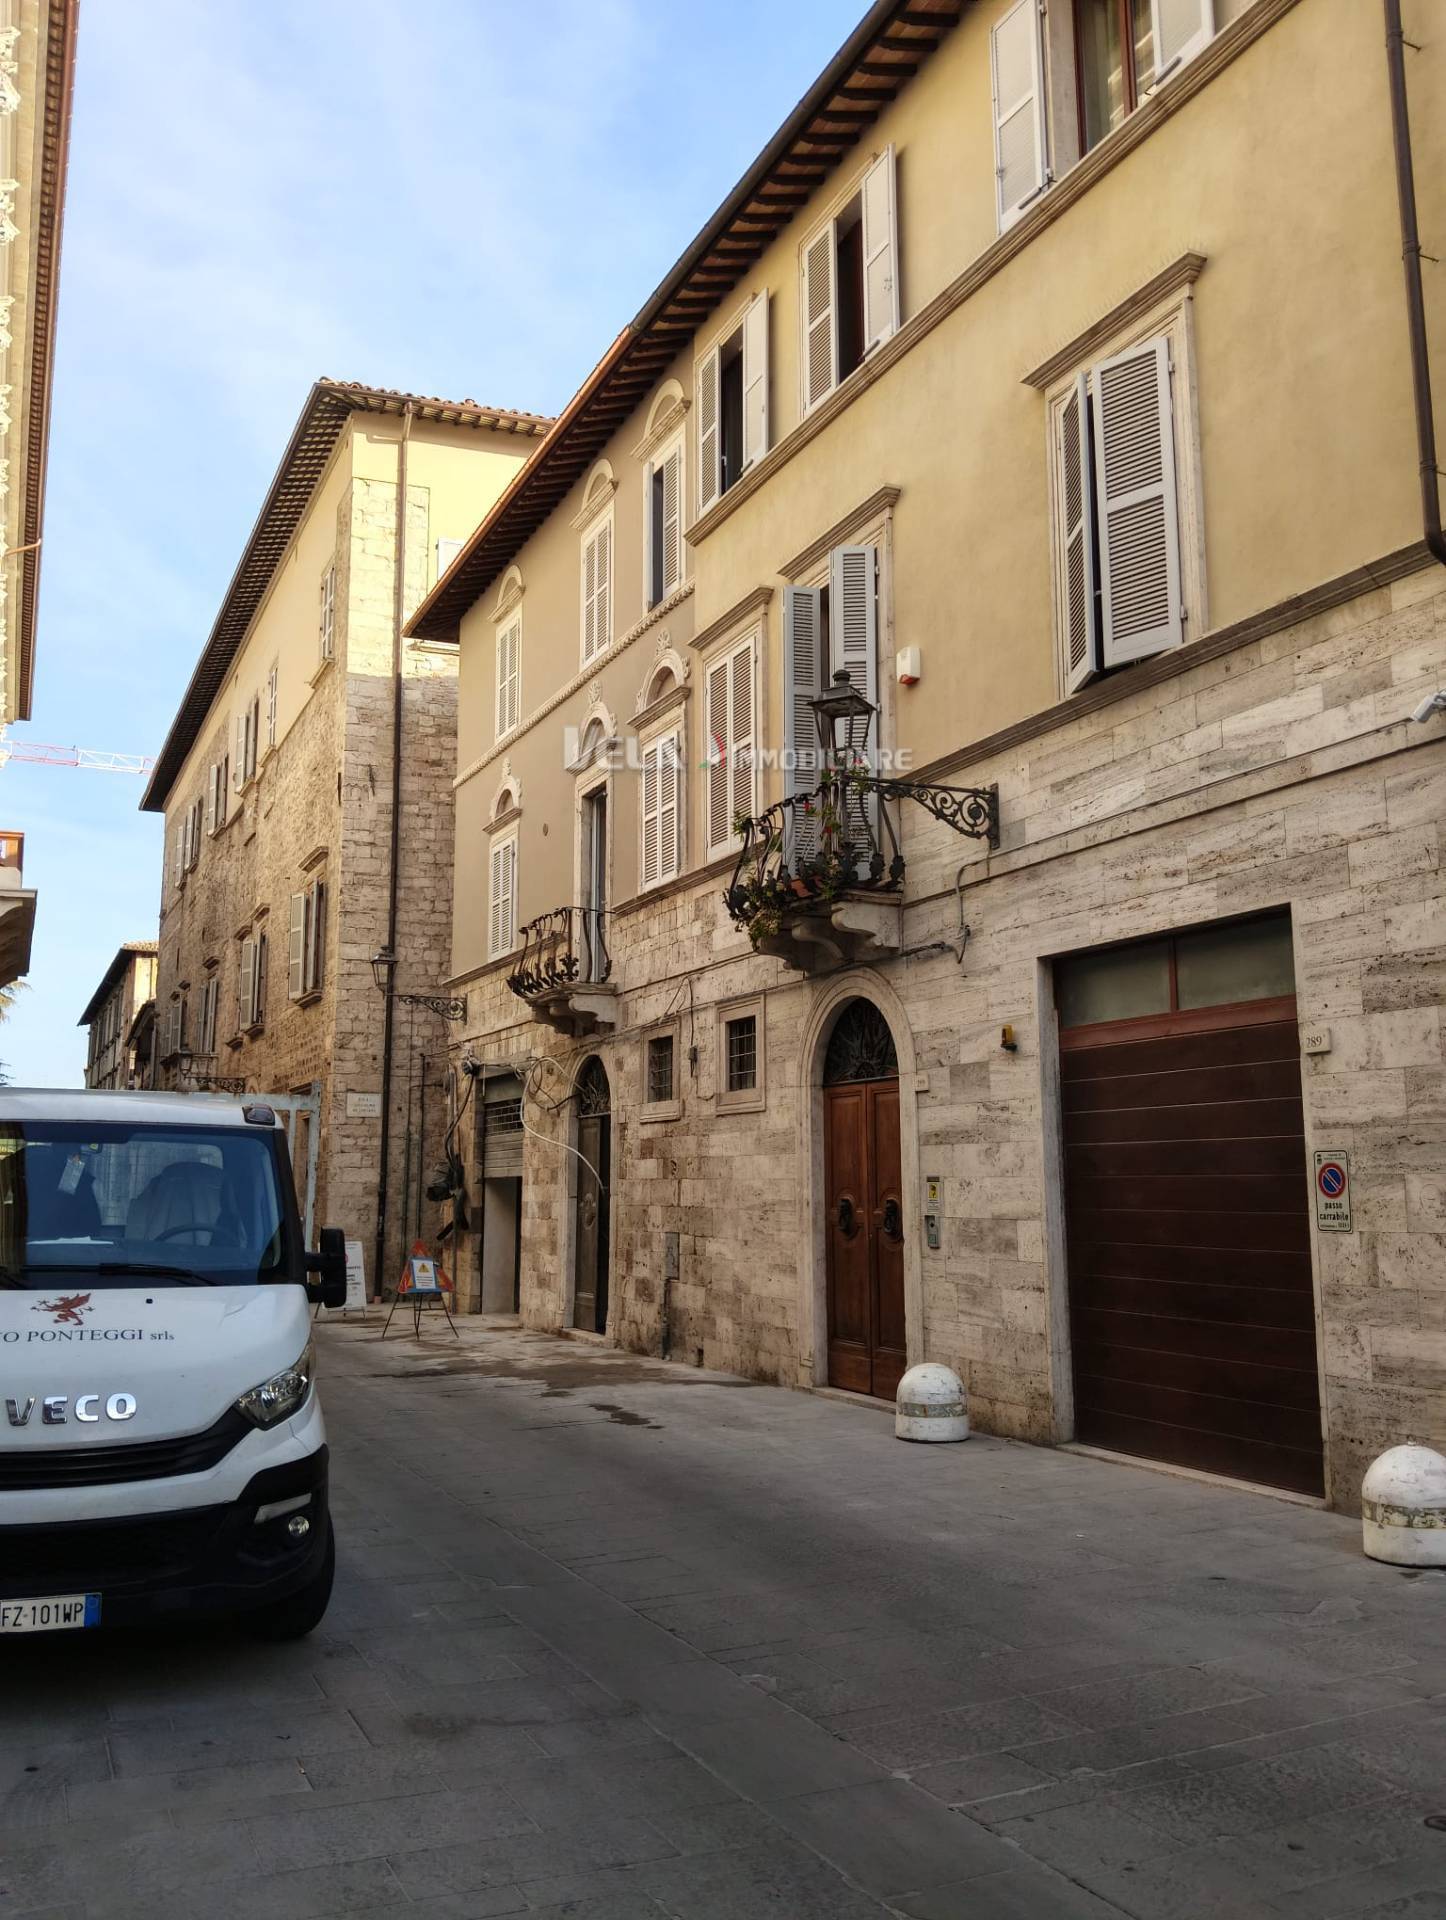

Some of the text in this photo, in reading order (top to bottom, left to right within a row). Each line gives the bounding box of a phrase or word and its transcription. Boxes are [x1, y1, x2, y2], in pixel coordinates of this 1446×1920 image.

[1306, 1035, 1322, 1048] 289
[1325, 1202, 1343, 1210] passo
[28, 1329, 144, 1342] PONTEGGI
[151, 1331, 174, 1341] srls
